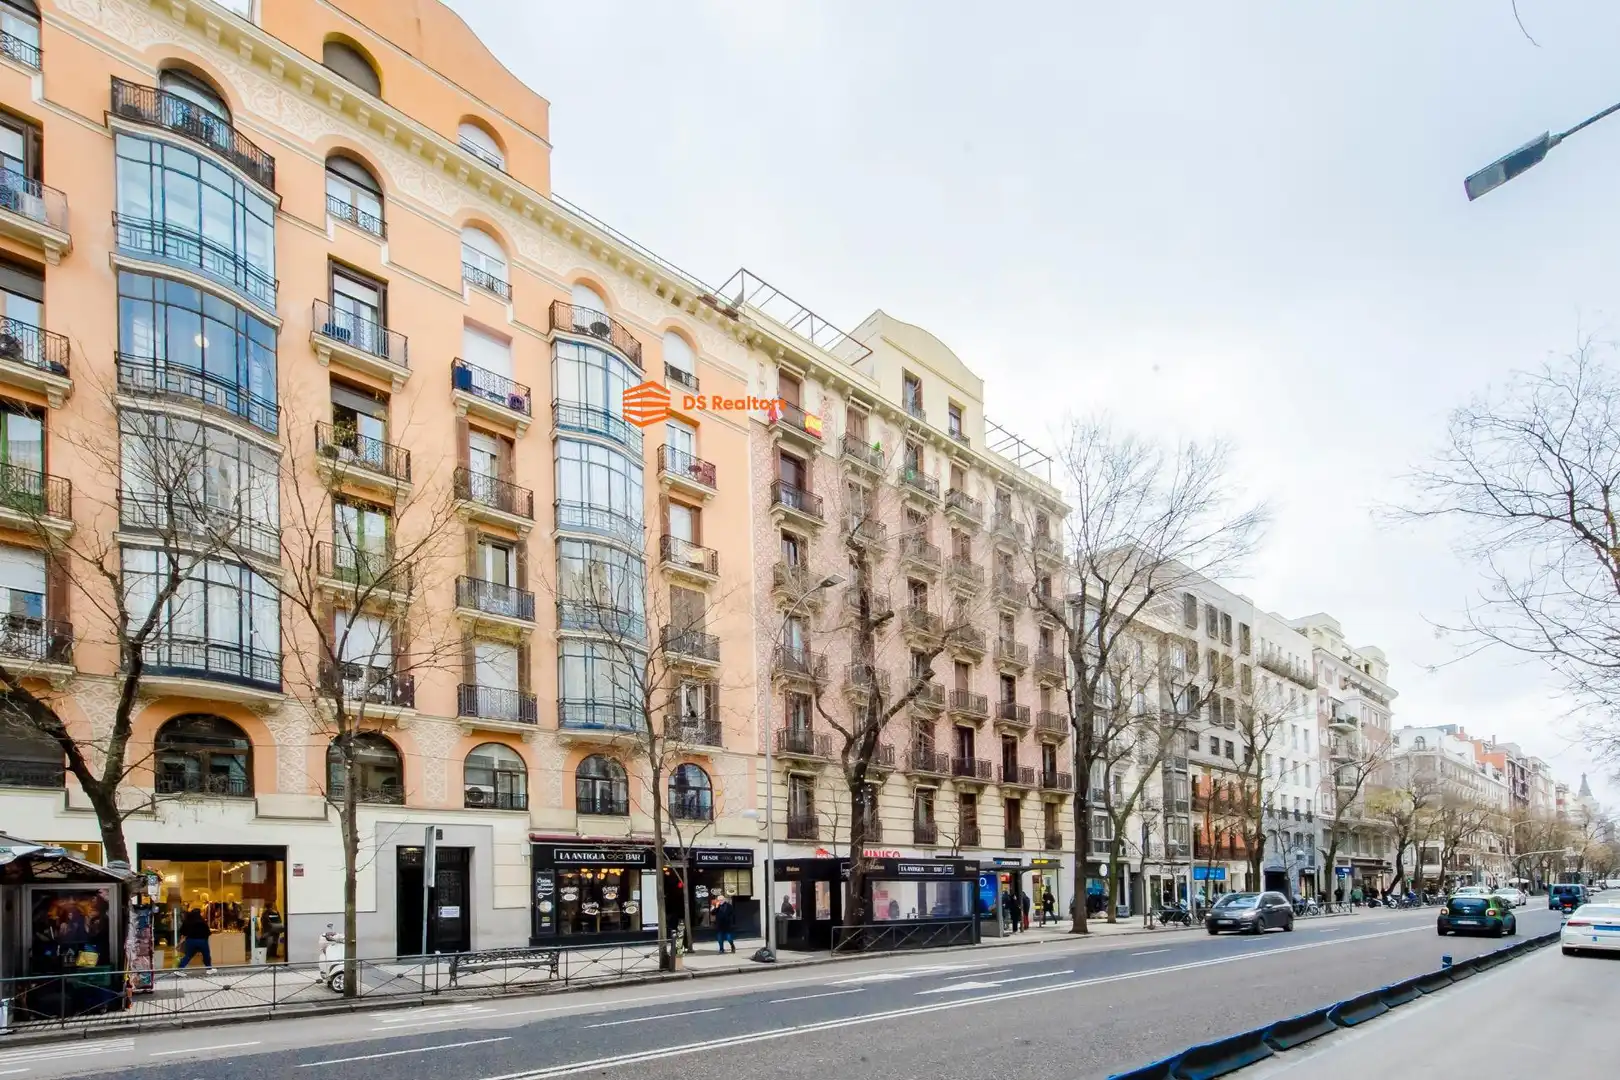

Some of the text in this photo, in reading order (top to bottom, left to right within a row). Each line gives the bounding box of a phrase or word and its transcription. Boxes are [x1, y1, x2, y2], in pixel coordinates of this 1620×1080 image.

[559, 852, 641, 861] LA ANTIGUA BAR
